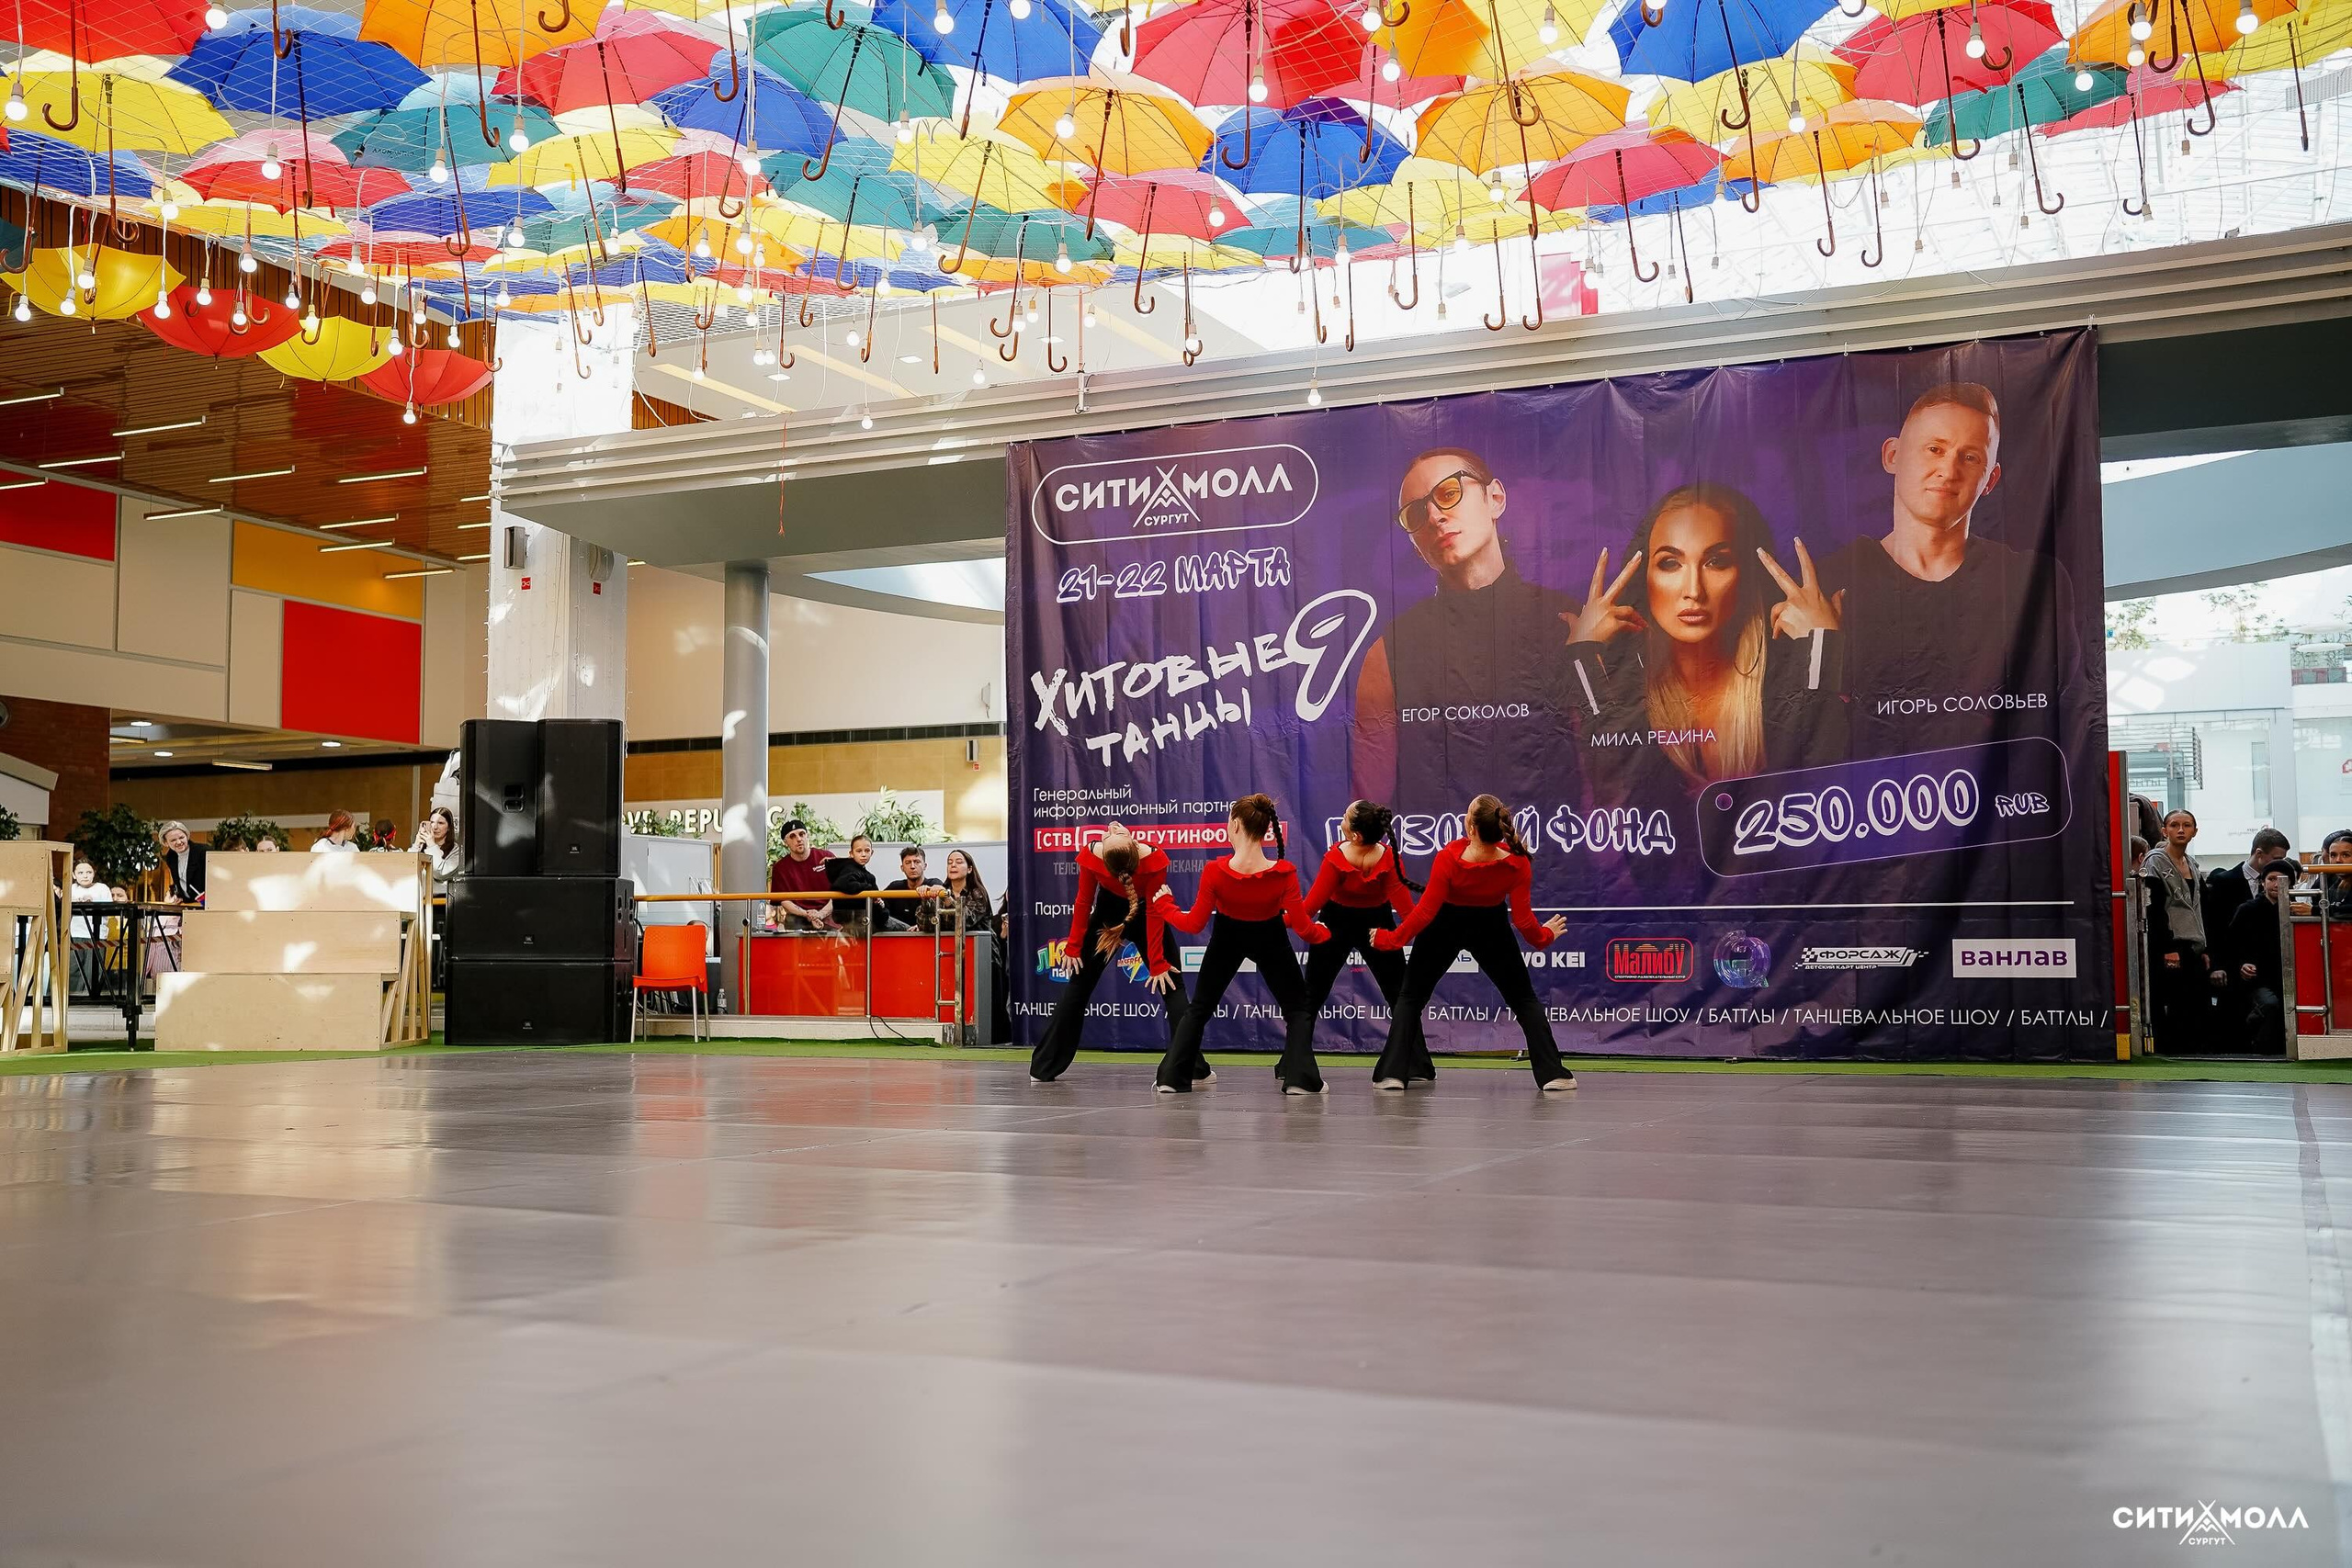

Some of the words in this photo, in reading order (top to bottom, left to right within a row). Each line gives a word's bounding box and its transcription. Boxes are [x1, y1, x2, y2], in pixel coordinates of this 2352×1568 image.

[1144, 513, 1190, 526] СУРГУТ
[1056, 561, 1168, 604] 21-22
[1174, 547, 1291, 593] МАРТА
[1030, 633, 1290, 736] ХИТОВЫЕ
[1402, 707, 1440, 722] ЕГОР
[1444, 704, 1530, 721] СОКОЛОВ
[1878, 699, 1938, 715] ИГОРЬ
[1943, 694, 2048, 712] СОЛОВЬЕВ
[1085, 688, 1251, 767] ТАНЦЫ
[1590, 732, 1643, 747] МИЛА
[1647, 728, 1717, 745] РЕДИНА
[1034, 784, 1132, 803] Генеральный
[1034, 799, 1178, 820] информационный
[1182, 800, 1237, 816] партне
[1733, 768, 1980, 855] 250.000
[1995, 793, 2051, 817] RUB
[1546, 805, 1676, 855] ФОНД
[1035, 901, 1096, 919] Партн
[1551, 952, 1586, 968] KEI
[1819, 950, 1901, 959] ФОРСАЖ
[1961, 948, 2069, 967] ванлав
[1124, 1003, 1160, 1018] ШОУ
[1429, 1006, 1488, 1021] БАТТЛЫ
[1645, 1008, 1690, 1023] ШОУ
[1708, 1009, 1775, 1024] БАТТЛЫ
[1793, 1009, 1945, 1026] ТАНЦЕВАЛЬНОЕ
[1951, 1010, 2000, 1026] ШОУ
[2021, 1010, 2094, 1027] БАТТЛЫ
